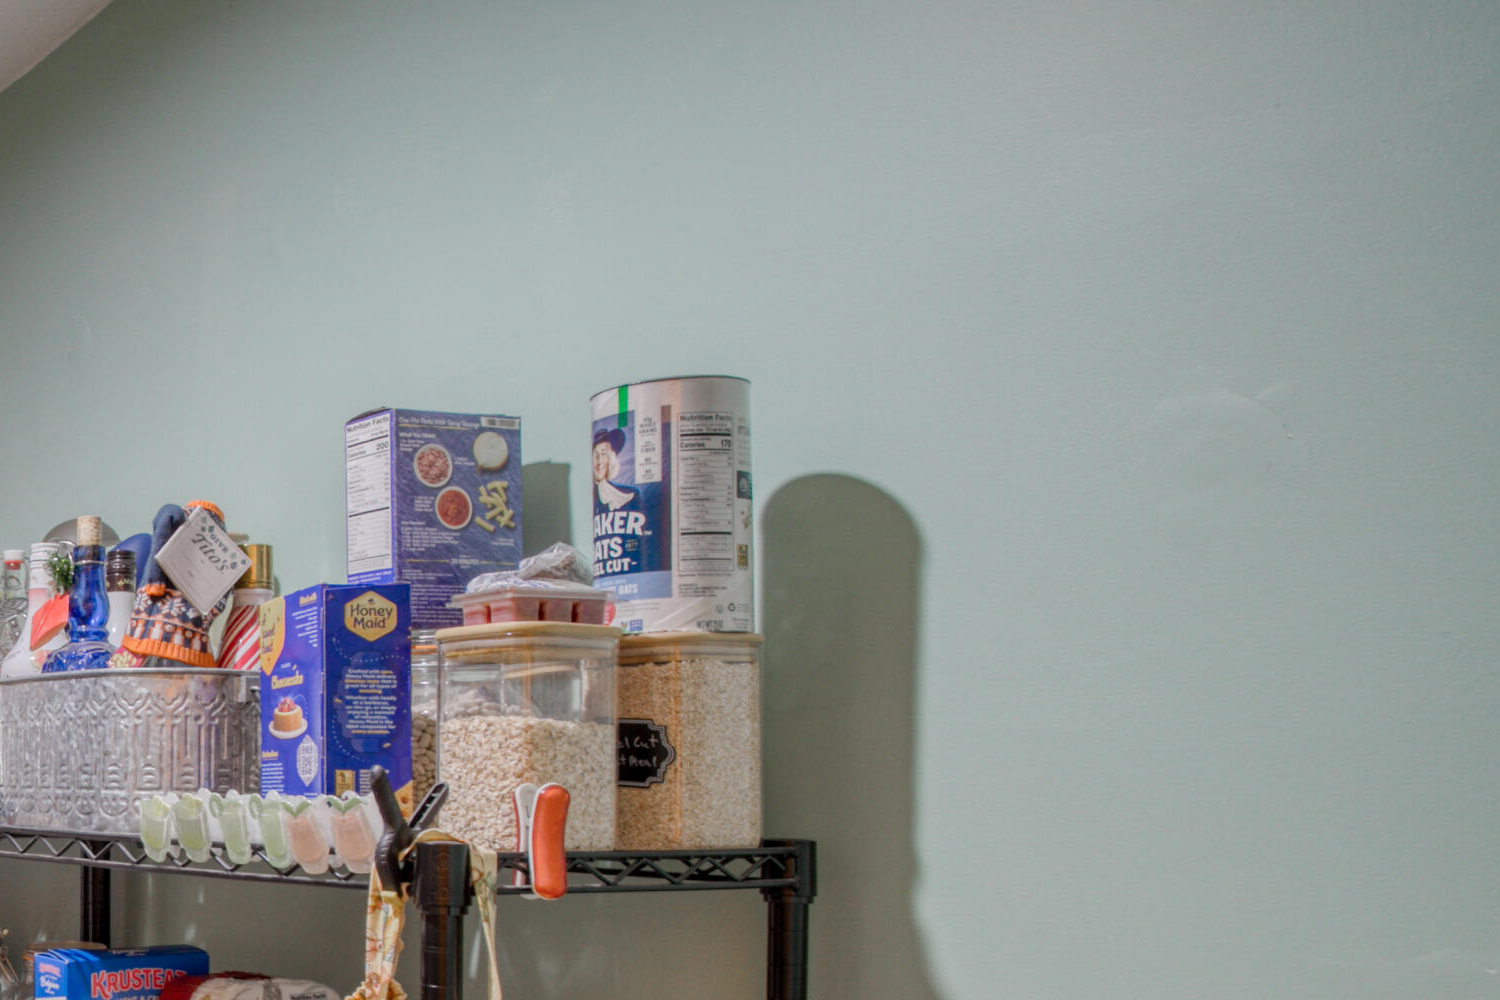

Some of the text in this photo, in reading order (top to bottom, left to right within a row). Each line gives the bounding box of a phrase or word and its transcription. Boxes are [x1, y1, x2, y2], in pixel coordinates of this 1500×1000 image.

[347, 416, 389, 433] Nutrition Facts
[376, 441, 389, 451] 200
[350, 604, 393, 620] Honey
[353, 617, 386, 629] Maid
